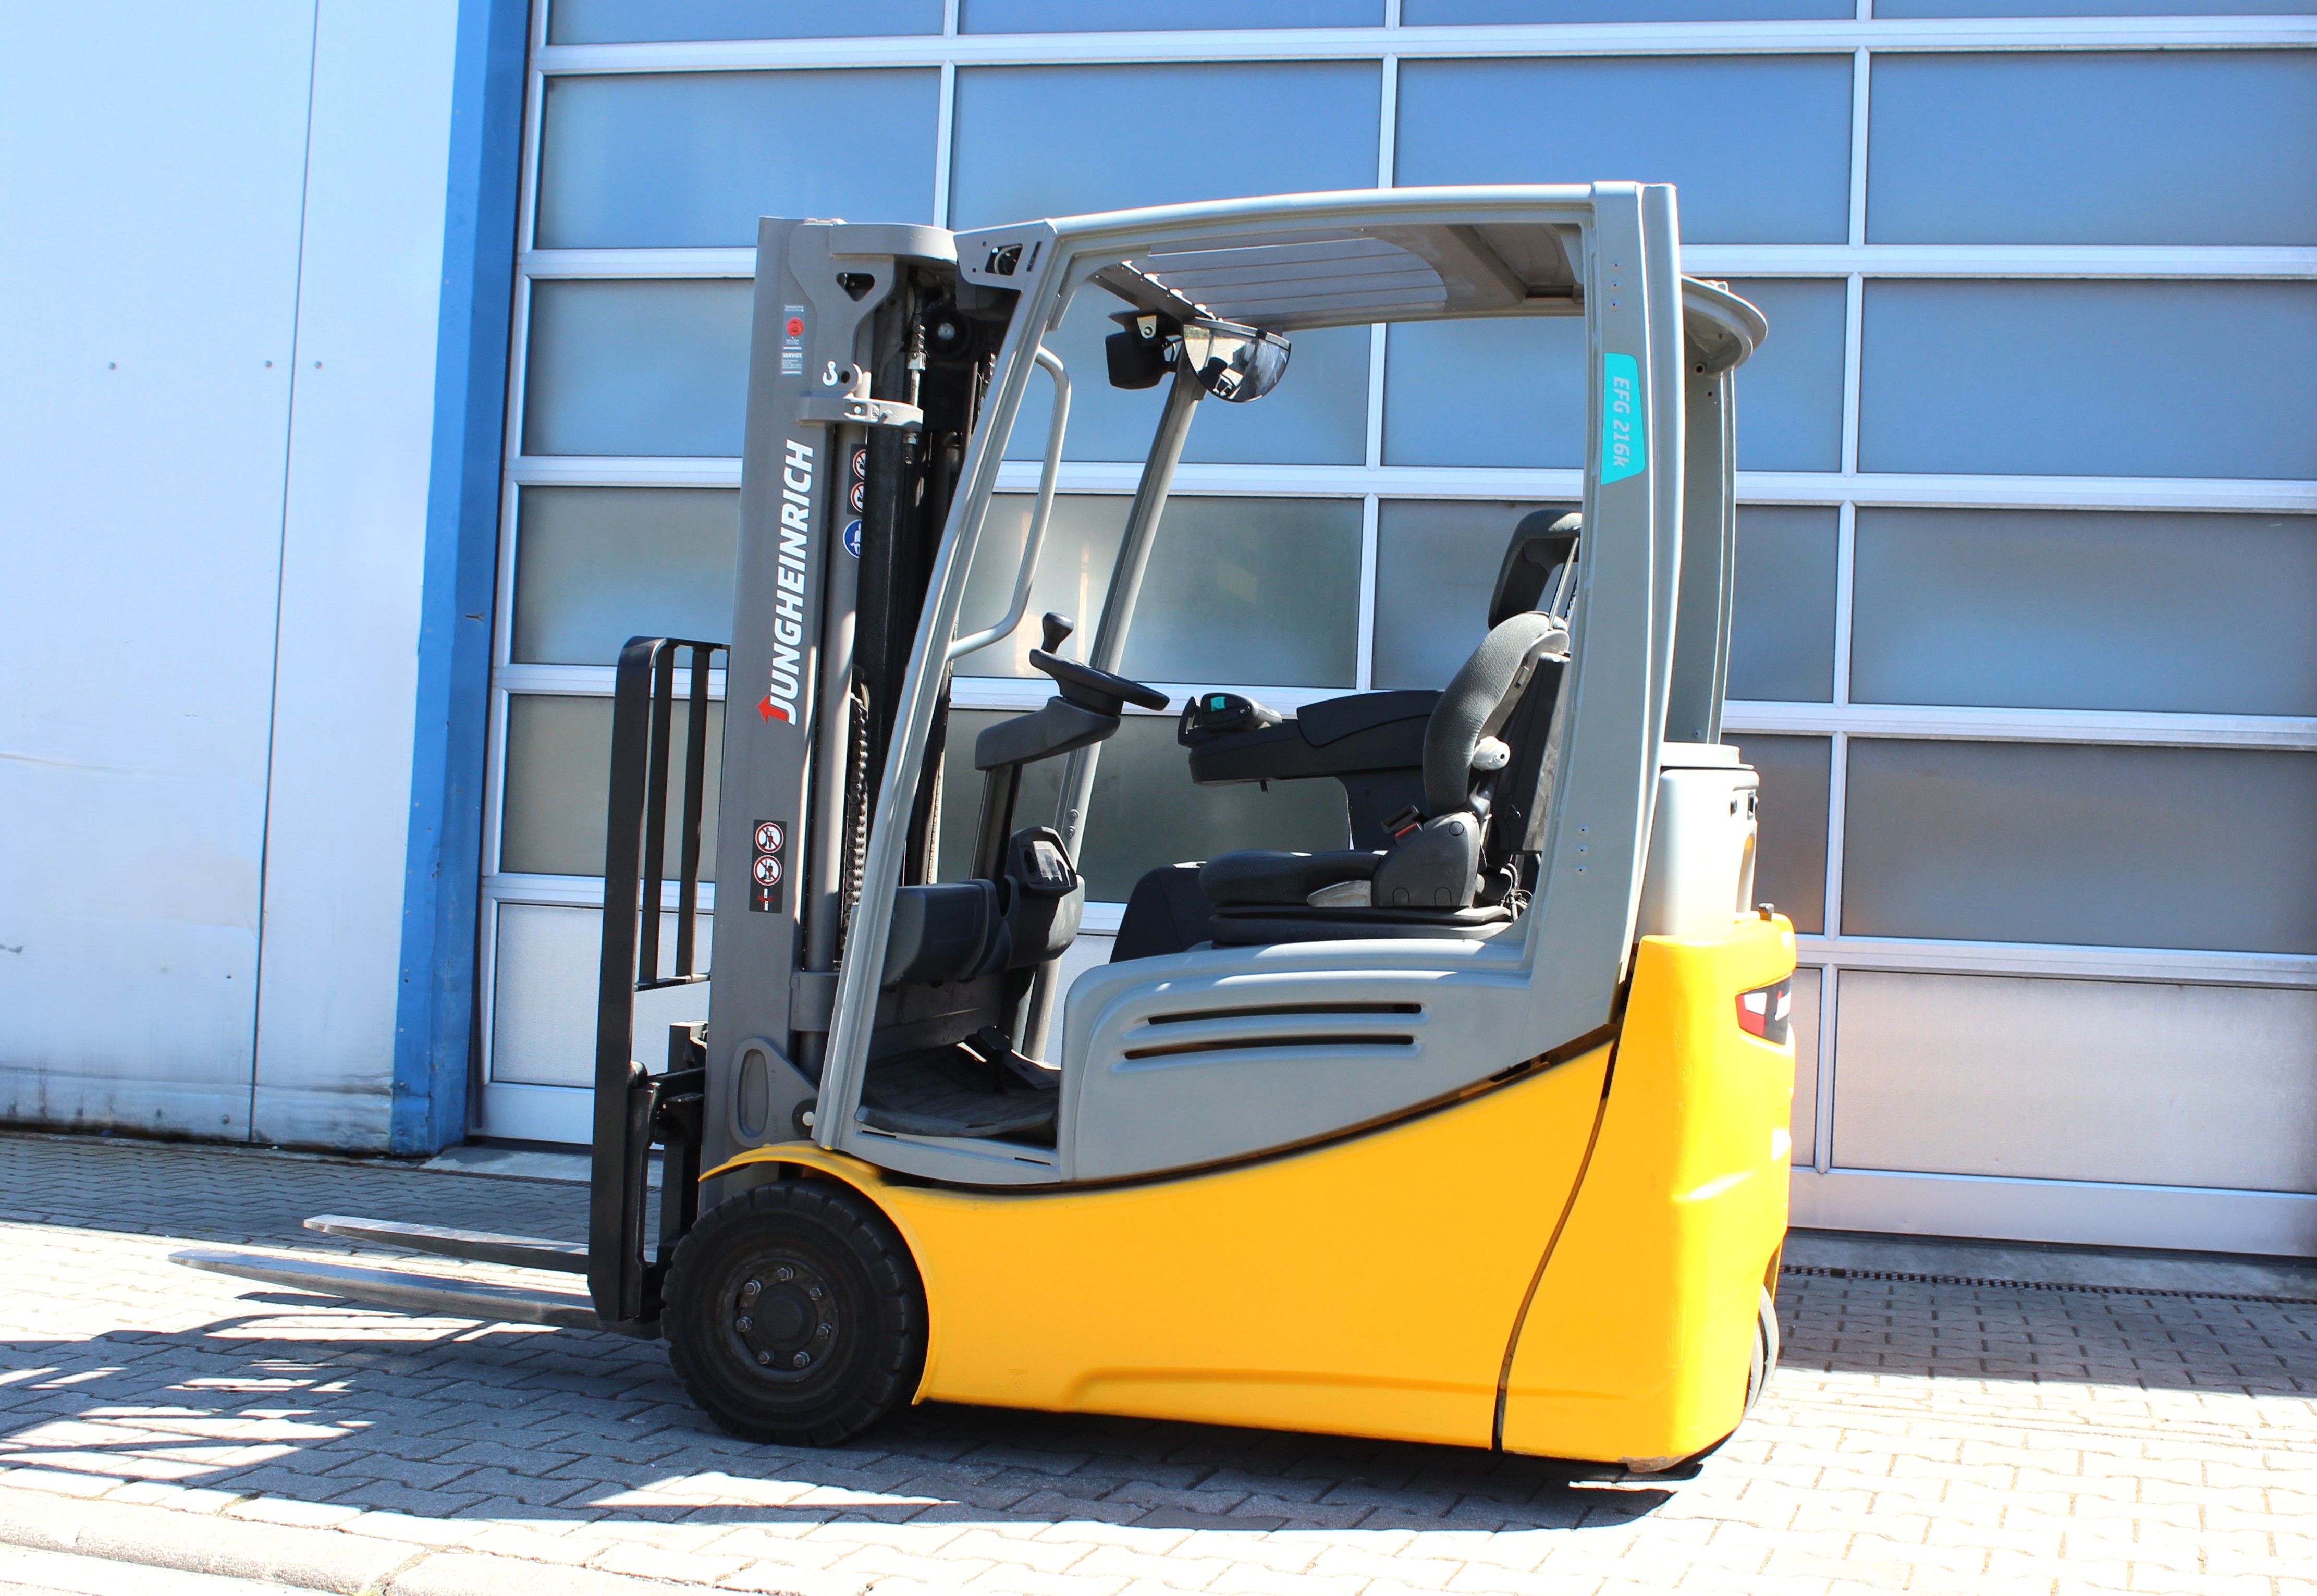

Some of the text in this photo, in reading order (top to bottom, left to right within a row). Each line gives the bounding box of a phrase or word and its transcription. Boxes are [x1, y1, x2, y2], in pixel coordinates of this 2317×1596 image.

[1613, 376, 1631, 468] EFG 216k
[757, 439, 813, 726] JUNGHEINRICH
